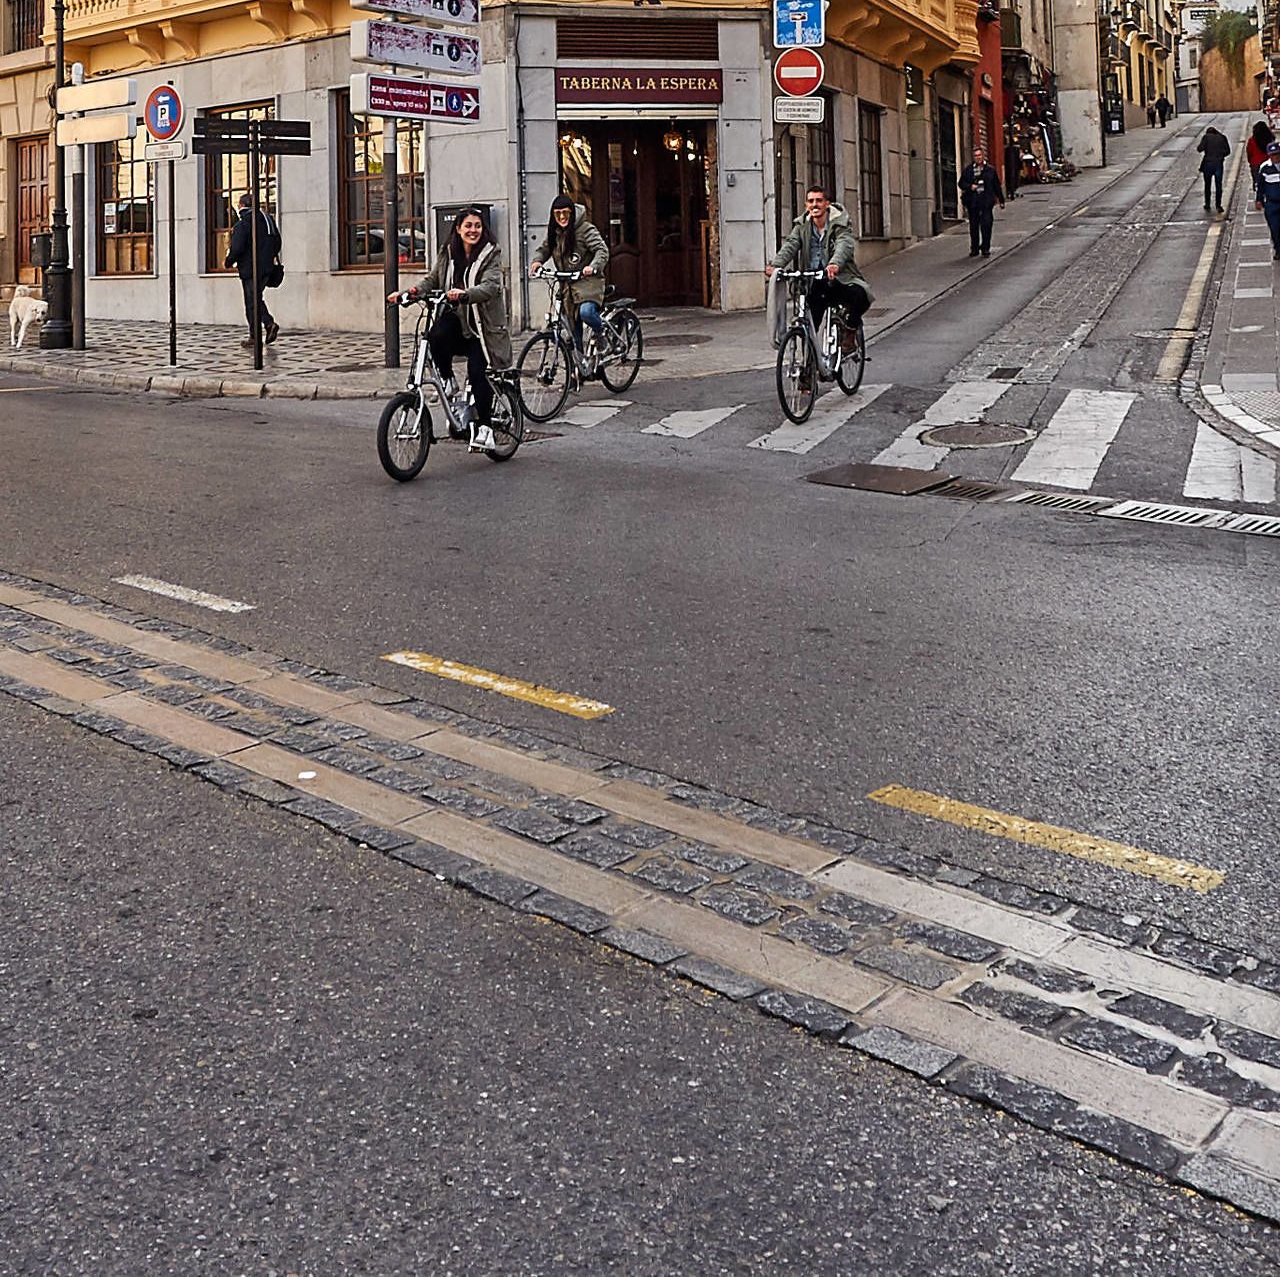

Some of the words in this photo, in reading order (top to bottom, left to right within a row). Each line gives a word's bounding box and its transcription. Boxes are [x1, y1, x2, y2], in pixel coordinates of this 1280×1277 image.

[559, 76, 632, 91] TABERNA
[636, 76, 657, 90] LA
[660, 76, 719, 91] ESPERA
[388, 85, 430, 97] monumental
[160, 107, 167, 119] P
